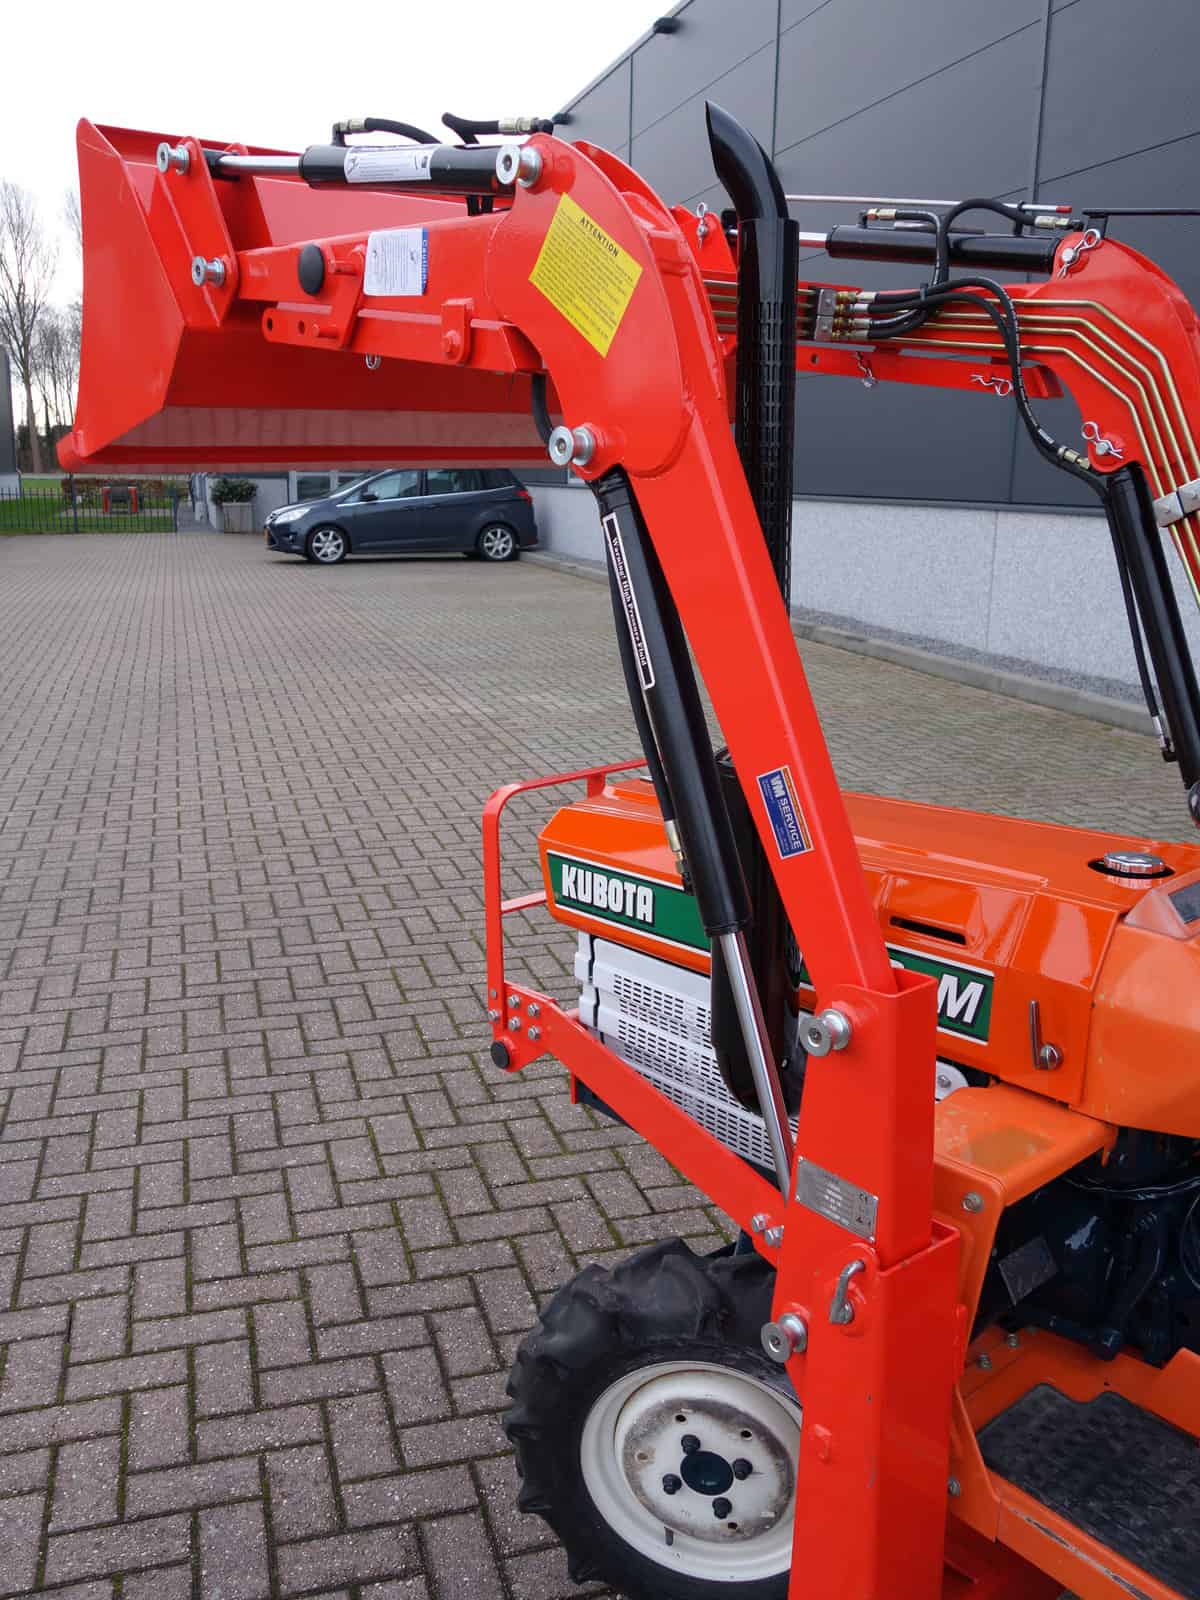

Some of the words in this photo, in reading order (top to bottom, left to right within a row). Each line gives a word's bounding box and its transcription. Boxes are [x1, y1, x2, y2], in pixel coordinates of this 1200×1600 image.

[579, 215, 619, 257] ATTENTION
[621, 581, 632, 602] High
[770, 774, 786, 798] VM
[780, 798, 802, 849] SERVICE
[562, 863, 654, 924] KUBOTA
